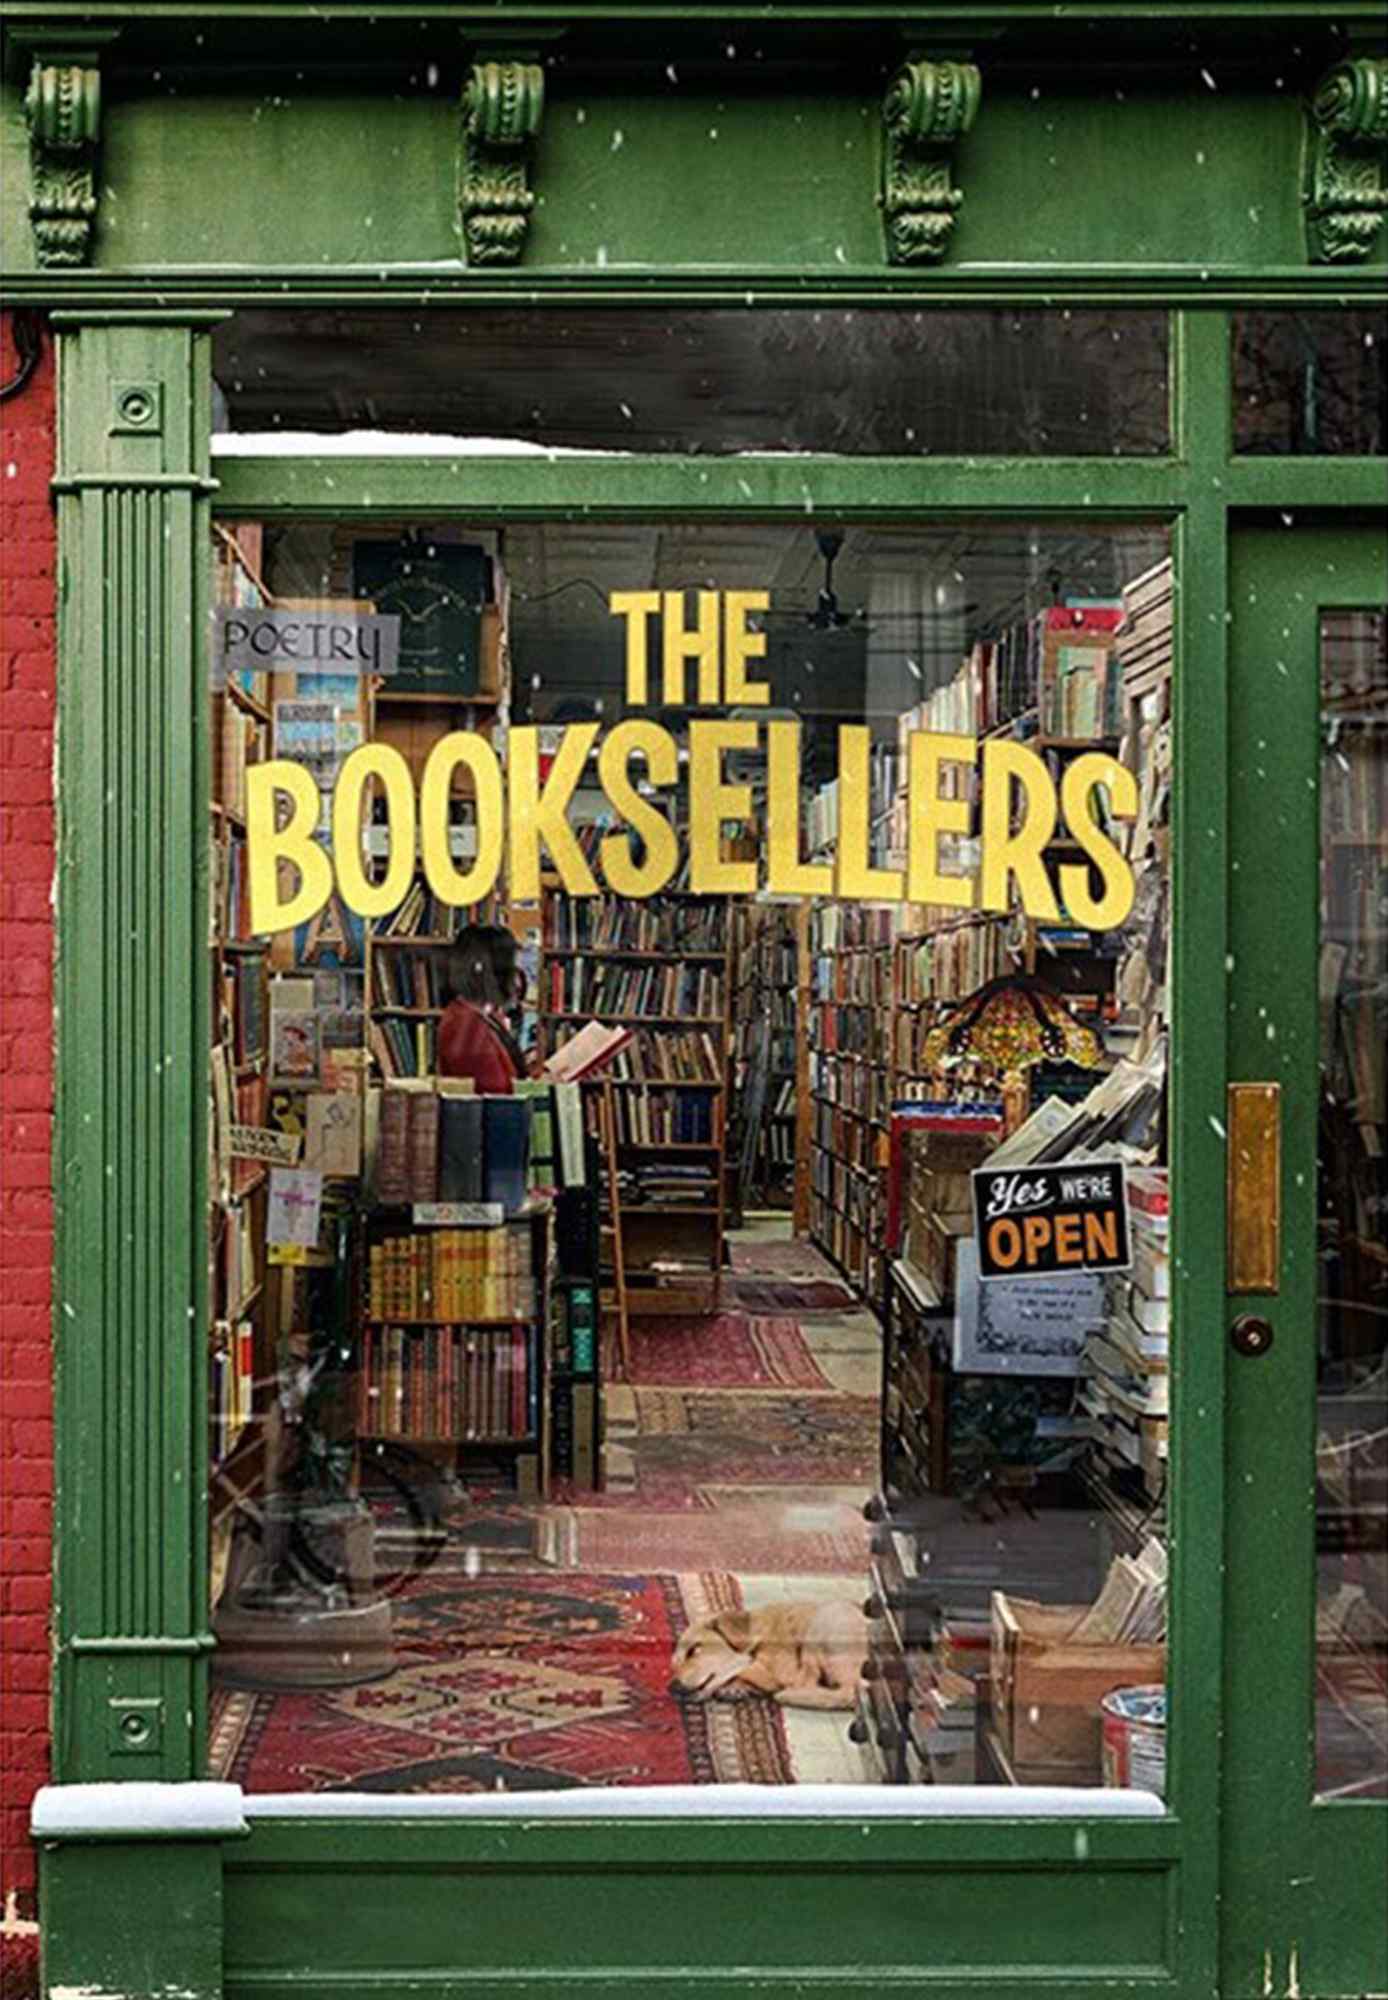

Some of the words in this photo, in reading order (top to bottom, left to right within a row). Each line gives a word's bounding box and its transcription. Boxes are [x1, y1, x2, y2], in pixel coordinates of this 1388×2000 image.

[223, 618, 382, 670] POETRY
[609, 590, 770, 705] THE
[246, 719, 1139, 936] BOOKSELLERS
[986, 1173, 1055, 1220] Yes
[1058, 1175, 1113, 1201] WE'RE
[988, 1210, 1119, 1268] OPEN
